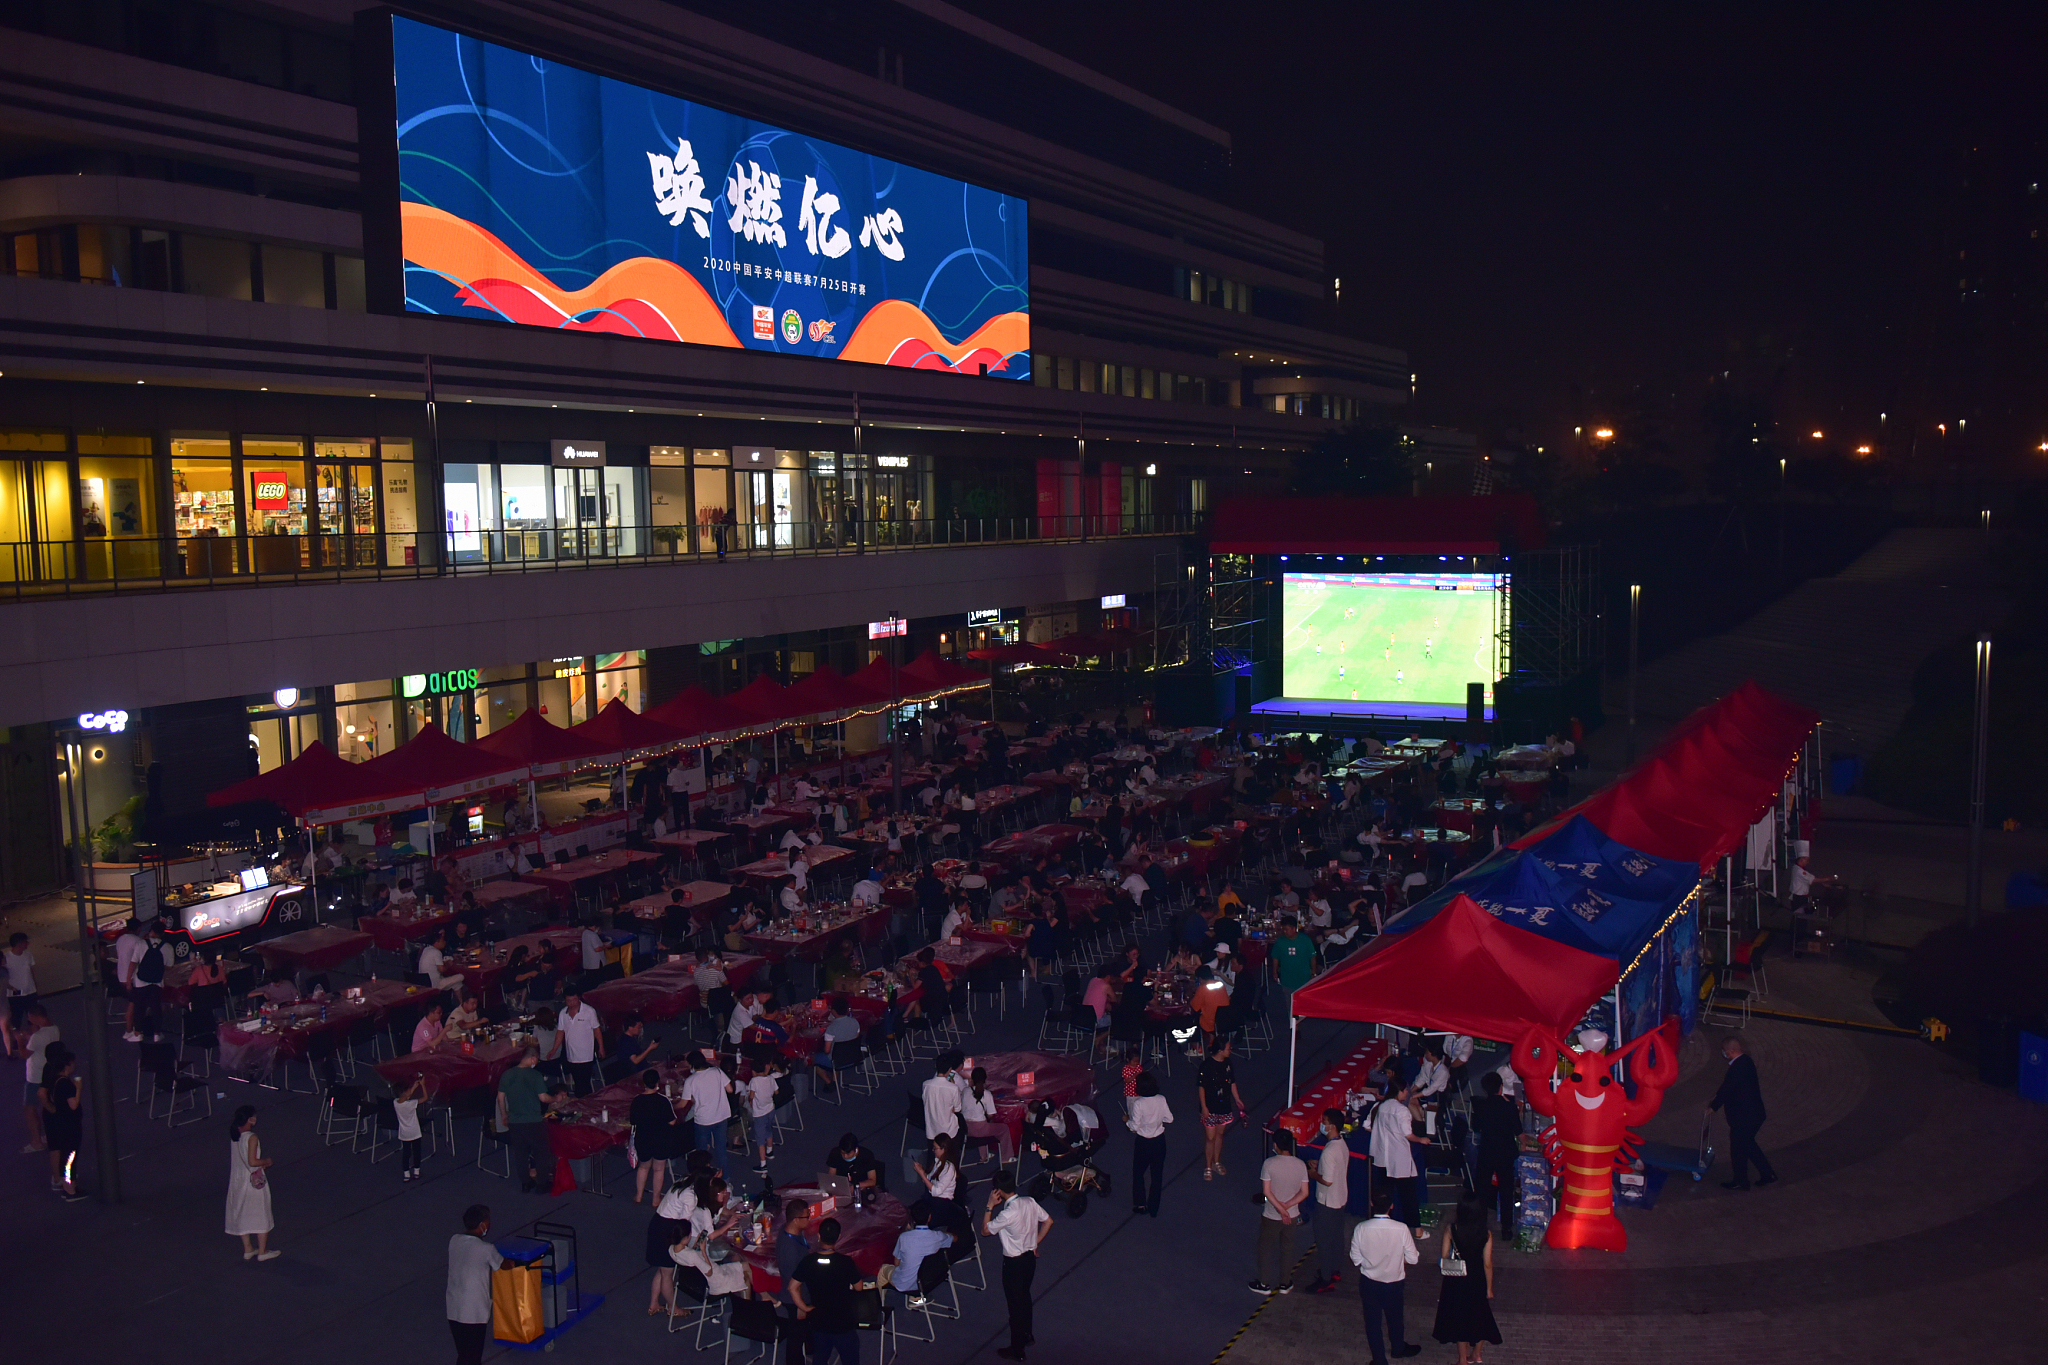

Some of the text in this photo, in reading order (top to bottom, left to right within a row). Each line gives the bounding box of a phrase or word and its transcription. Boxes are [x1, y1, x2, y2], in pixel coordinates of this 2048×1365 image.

[646, 136, 906, 262] 唤燃亿心
[703, 256, 867, 296] 2020中国平安中超联赛7月25日开赛
[257, 483, 285, 498] LEGO
